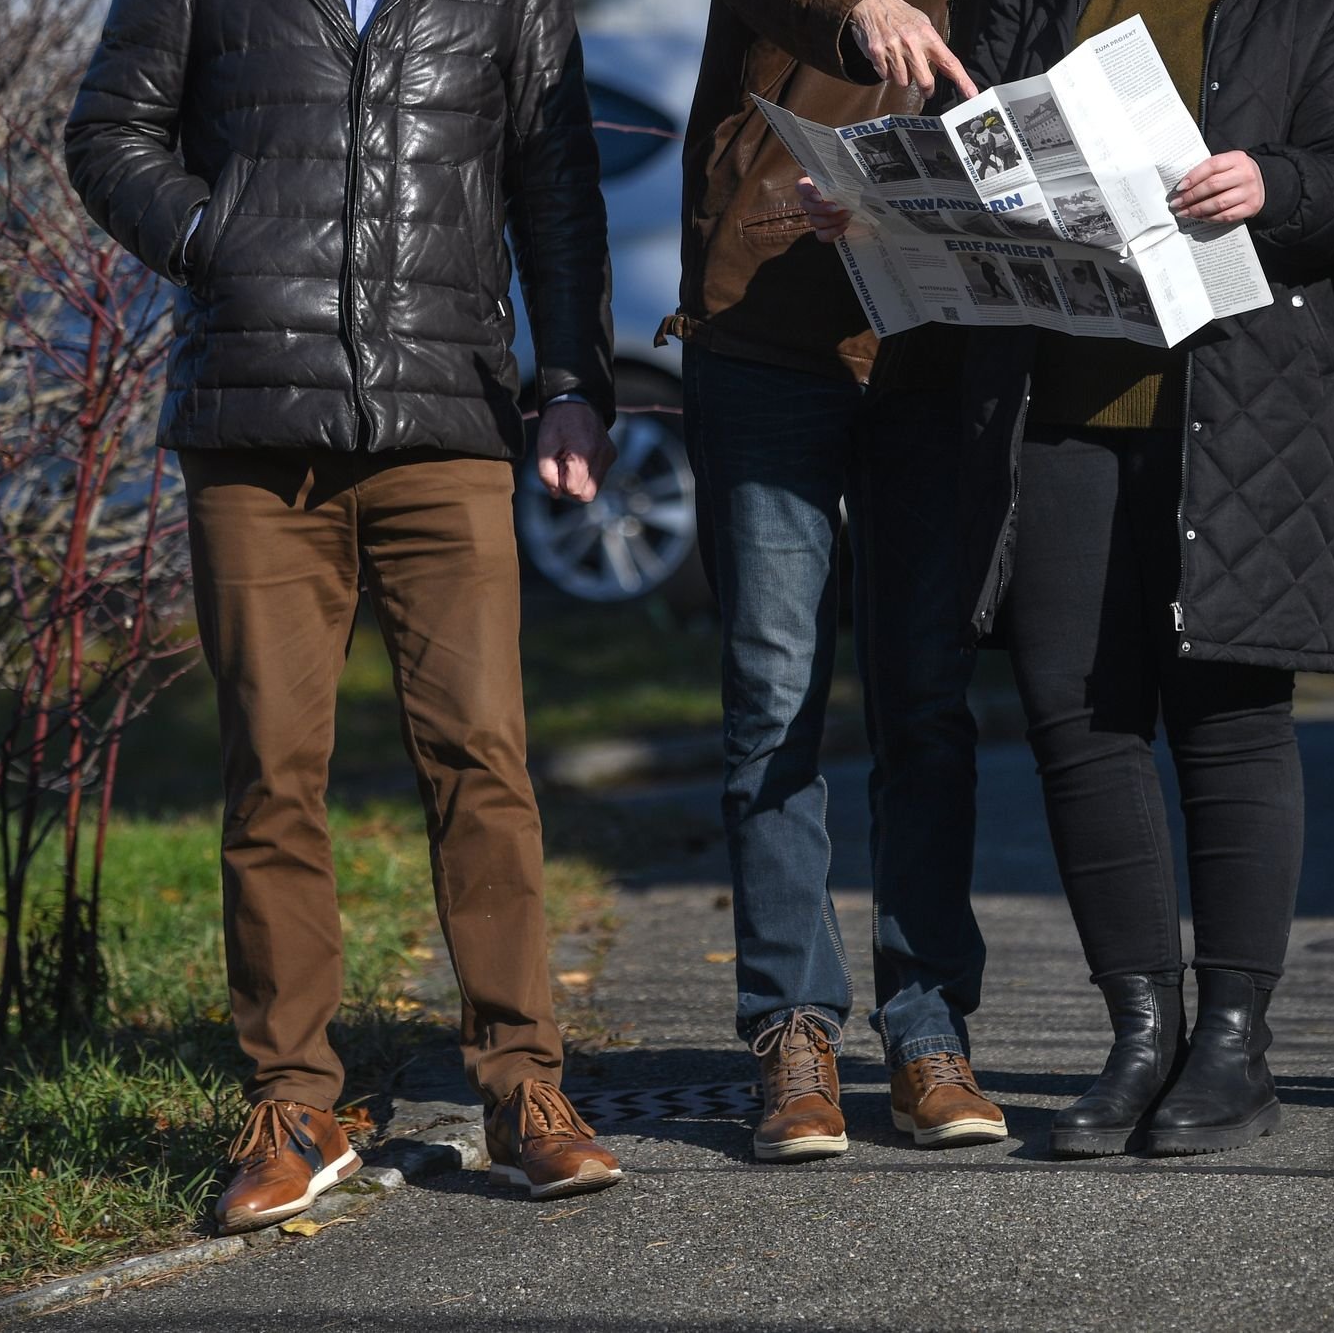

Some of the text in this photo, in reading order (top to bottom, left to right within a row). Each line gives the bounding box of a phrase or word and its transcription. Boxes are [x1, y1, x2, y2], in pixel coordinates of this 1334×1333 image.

[840, 117, 939, 140] ERLEBEN
[944, 239, 1055, 259] ERFAHREN
[851, 268, 887, 335] HEIMATKUNDE
